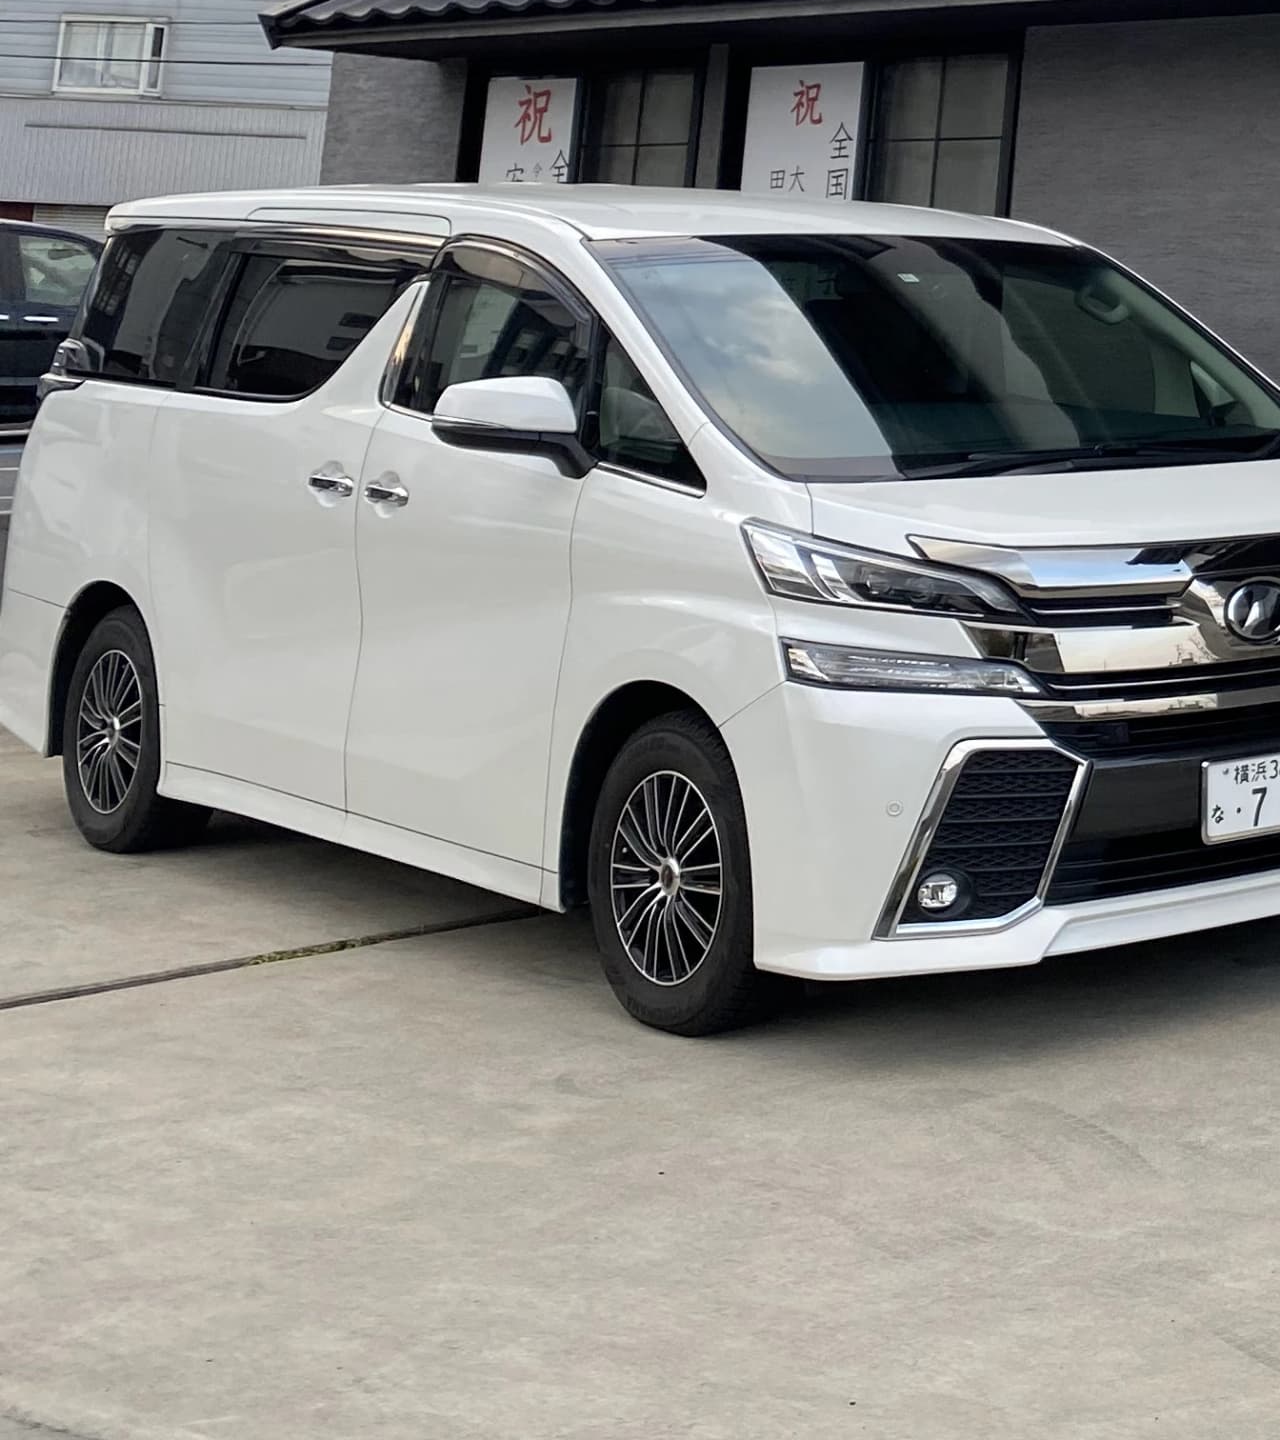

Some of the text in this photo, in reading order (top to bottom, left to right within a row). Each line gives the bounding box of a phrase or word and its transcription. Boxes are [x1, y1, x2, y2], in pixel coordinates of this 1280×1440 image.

[514, 84, 552, 146] 祝
[791, 80, 823, 127] 祝
[770, 170, 785, 190] 田
[789, 165, 805, 192] 大
[825, 122, 854, 200] 全国
